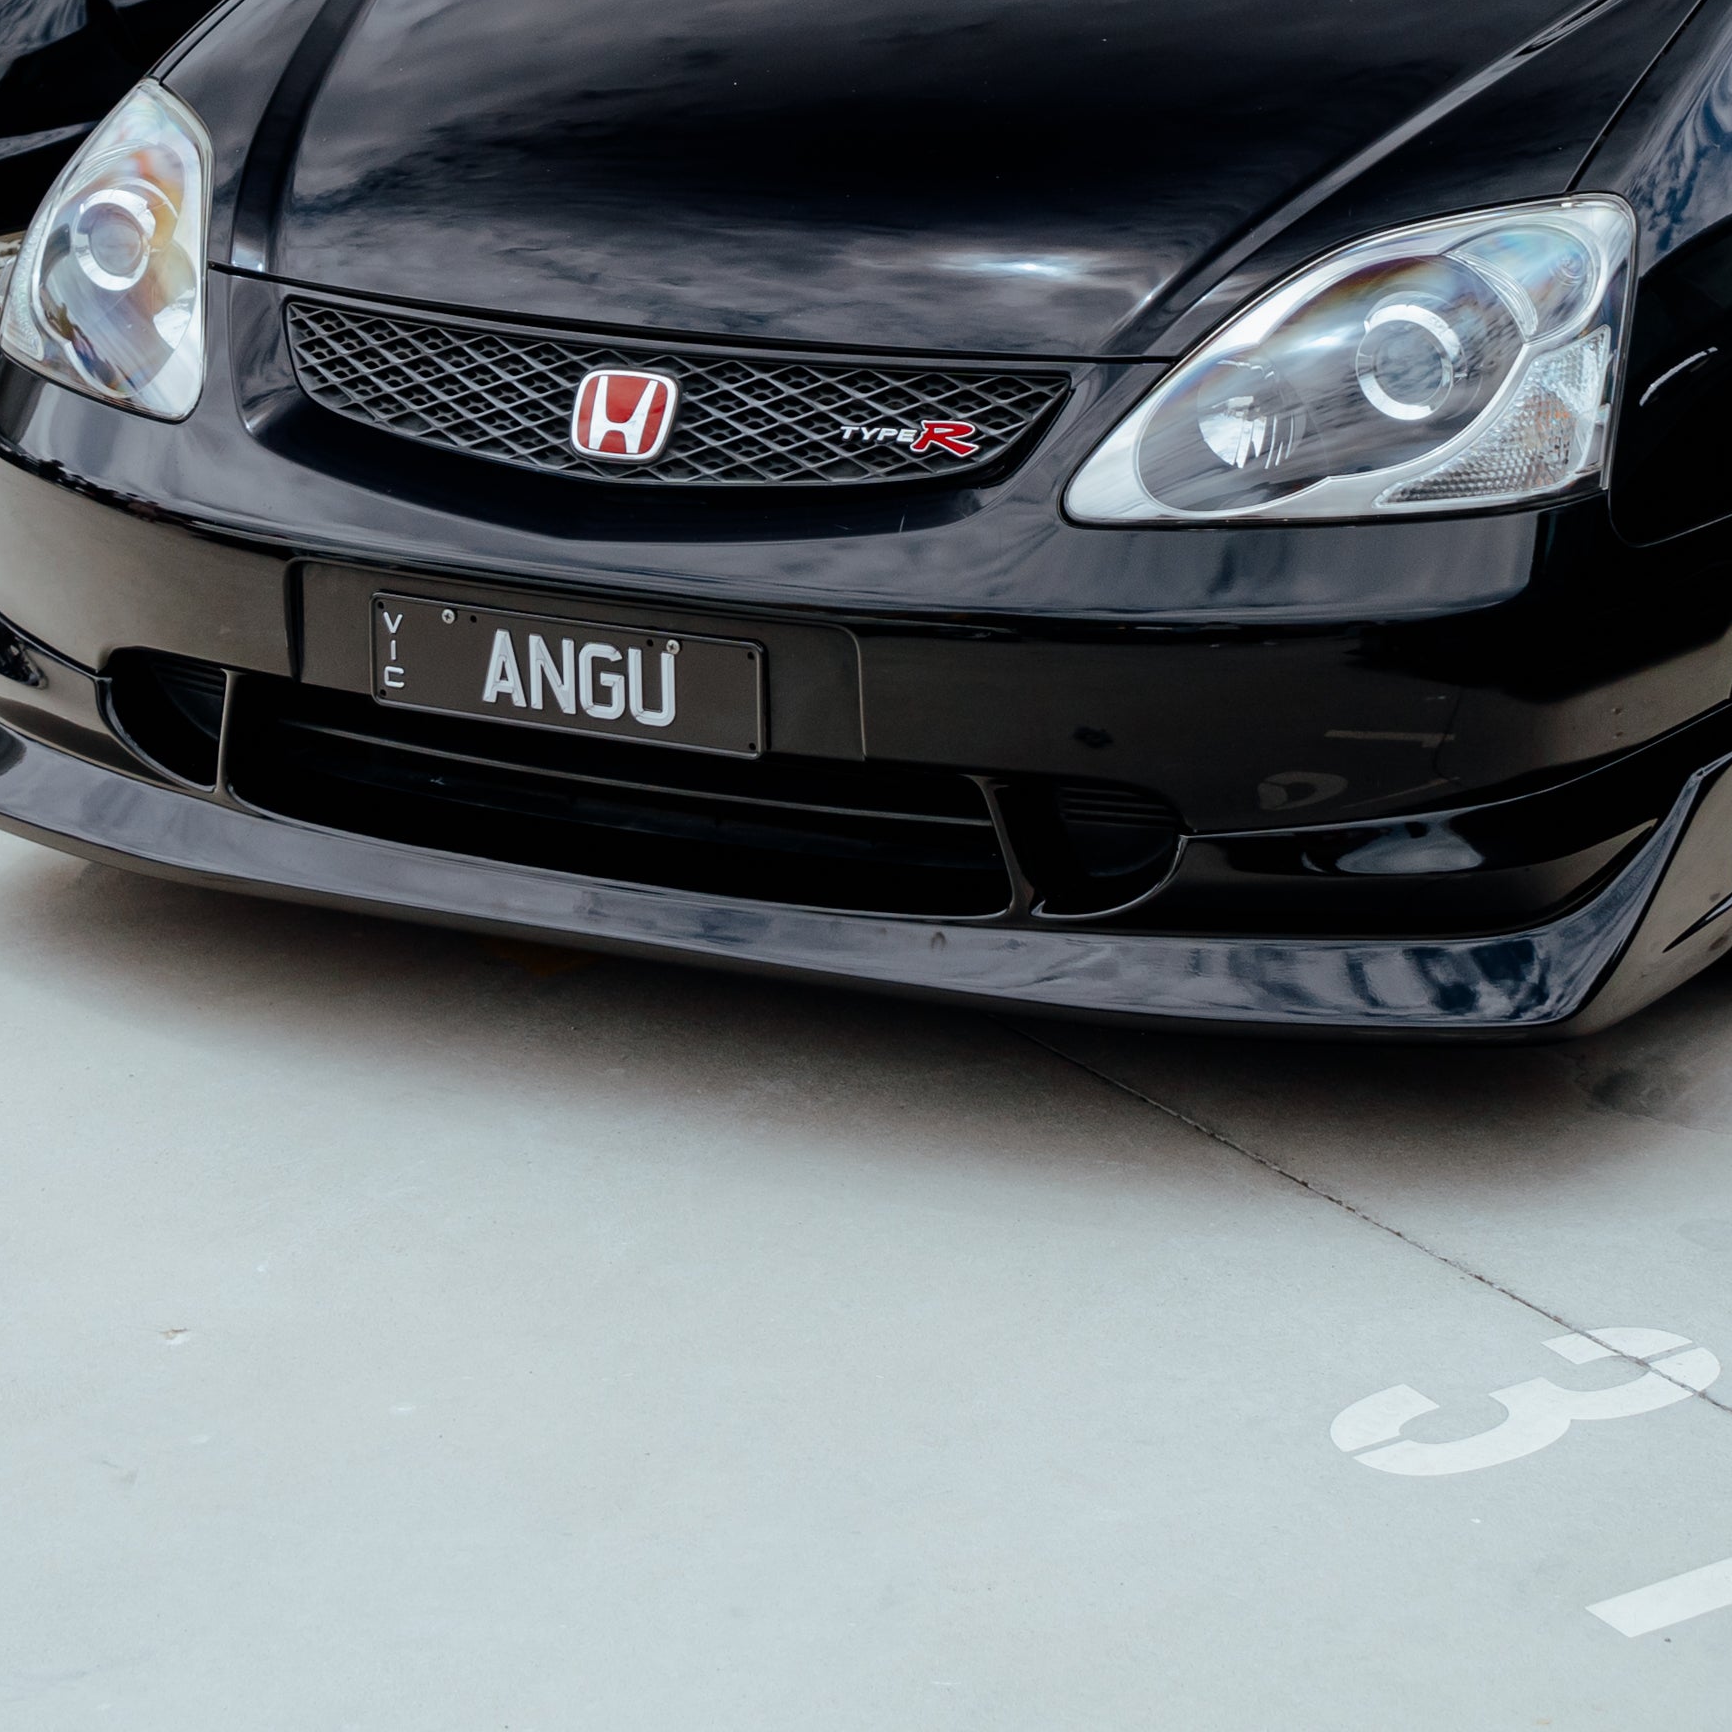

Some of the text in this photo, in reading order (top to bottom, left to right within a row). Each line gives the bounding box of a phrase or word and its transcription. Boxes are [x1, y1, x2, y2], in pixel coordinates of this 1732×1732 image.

[840, 419, 981, 457] TYPE R
[481, 628, 677, 728] ANGU
